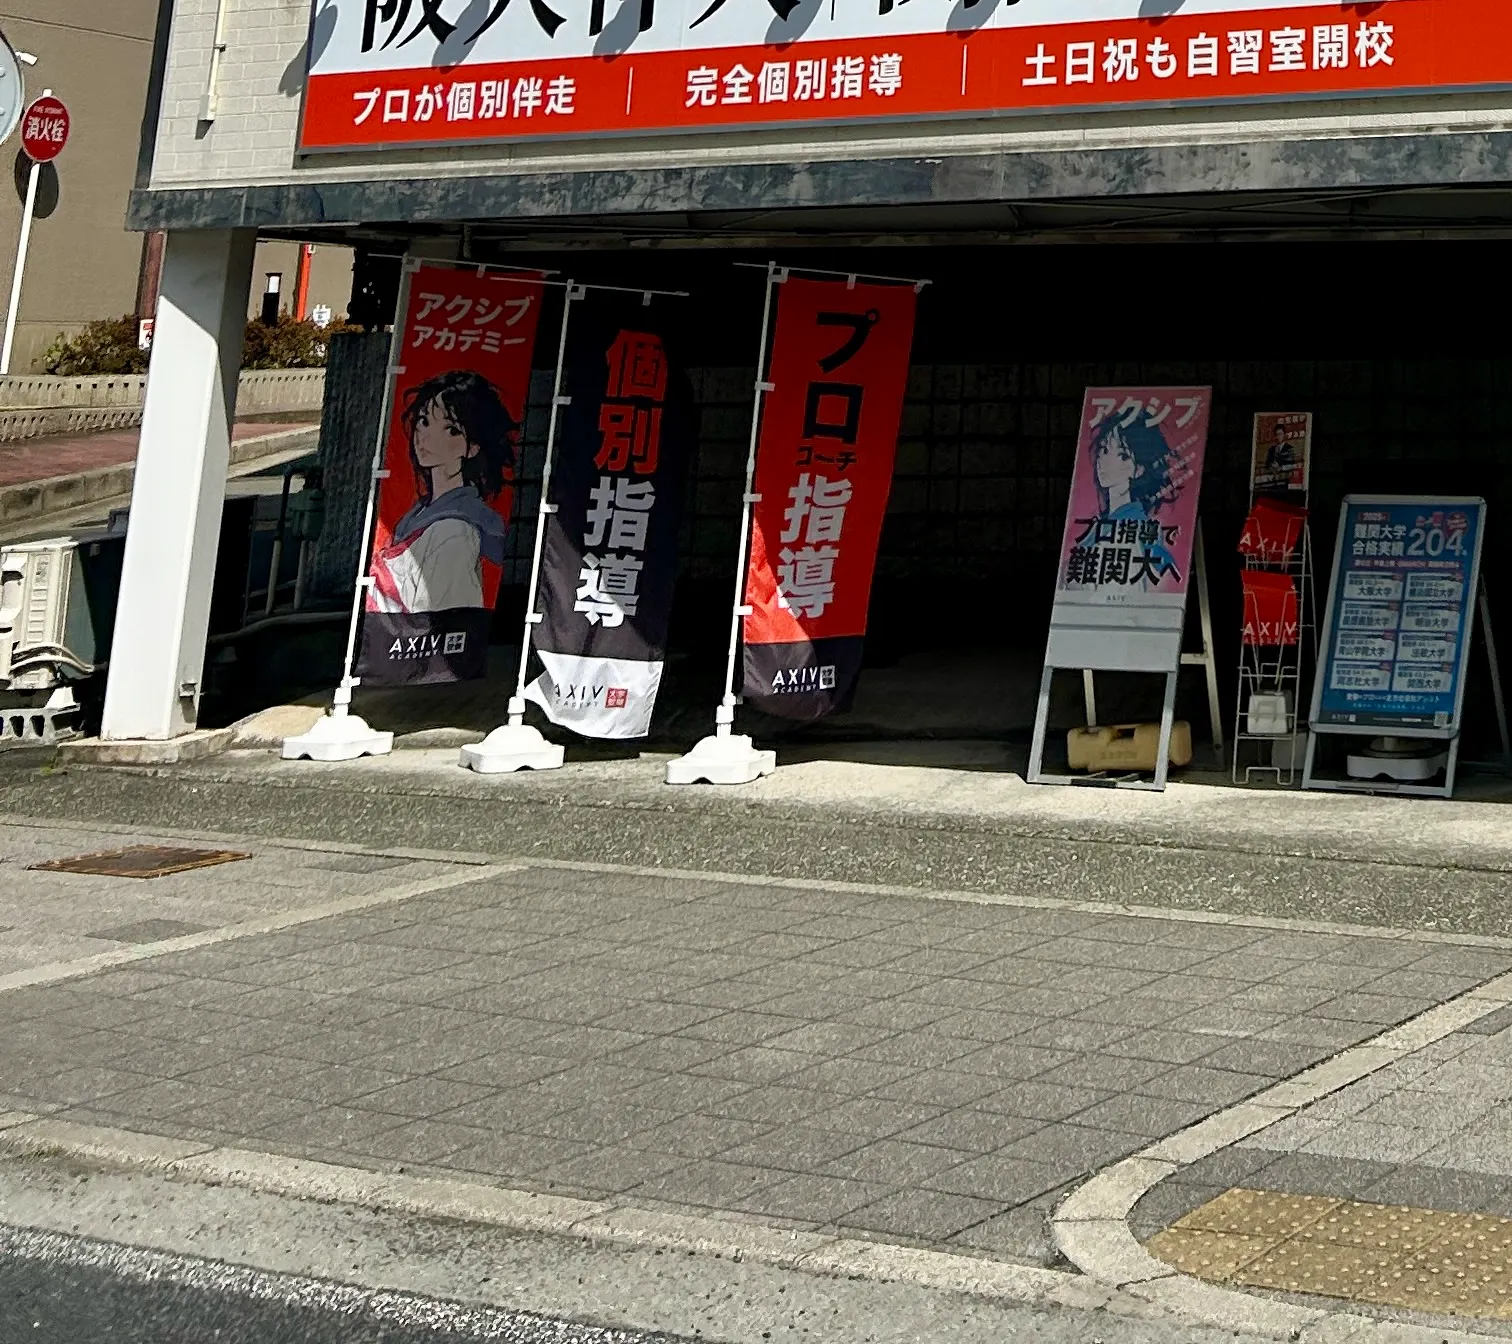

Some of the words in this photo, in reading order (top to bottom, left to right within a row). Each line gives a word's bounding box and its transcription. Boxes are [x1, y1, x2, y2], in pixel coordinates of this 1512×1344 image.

[352, 76, 577, 126] プロが個別伴走
[685, 53, 904, 109] 完全個別指導
[1021, 20, 1395, 87] 土日祝も自習室開校
[25, 115, 67, 142] 消火栓
[414, 292, 536, 324] アクシブ
[411, 323, 526, 355] アカデミー
[1088, 394, 1204, 429] アクシブ
[573, 327, 671, 629] 個別指導
[1073, 515, 1181, 547] プロ指導で
[1065, 545, 1183, 587] 難関大へ
[388, 633, 442, 654] AXIV
[1243, 621, 1298, 637] AXIV
[771, 666, 819, 687] AXIV
